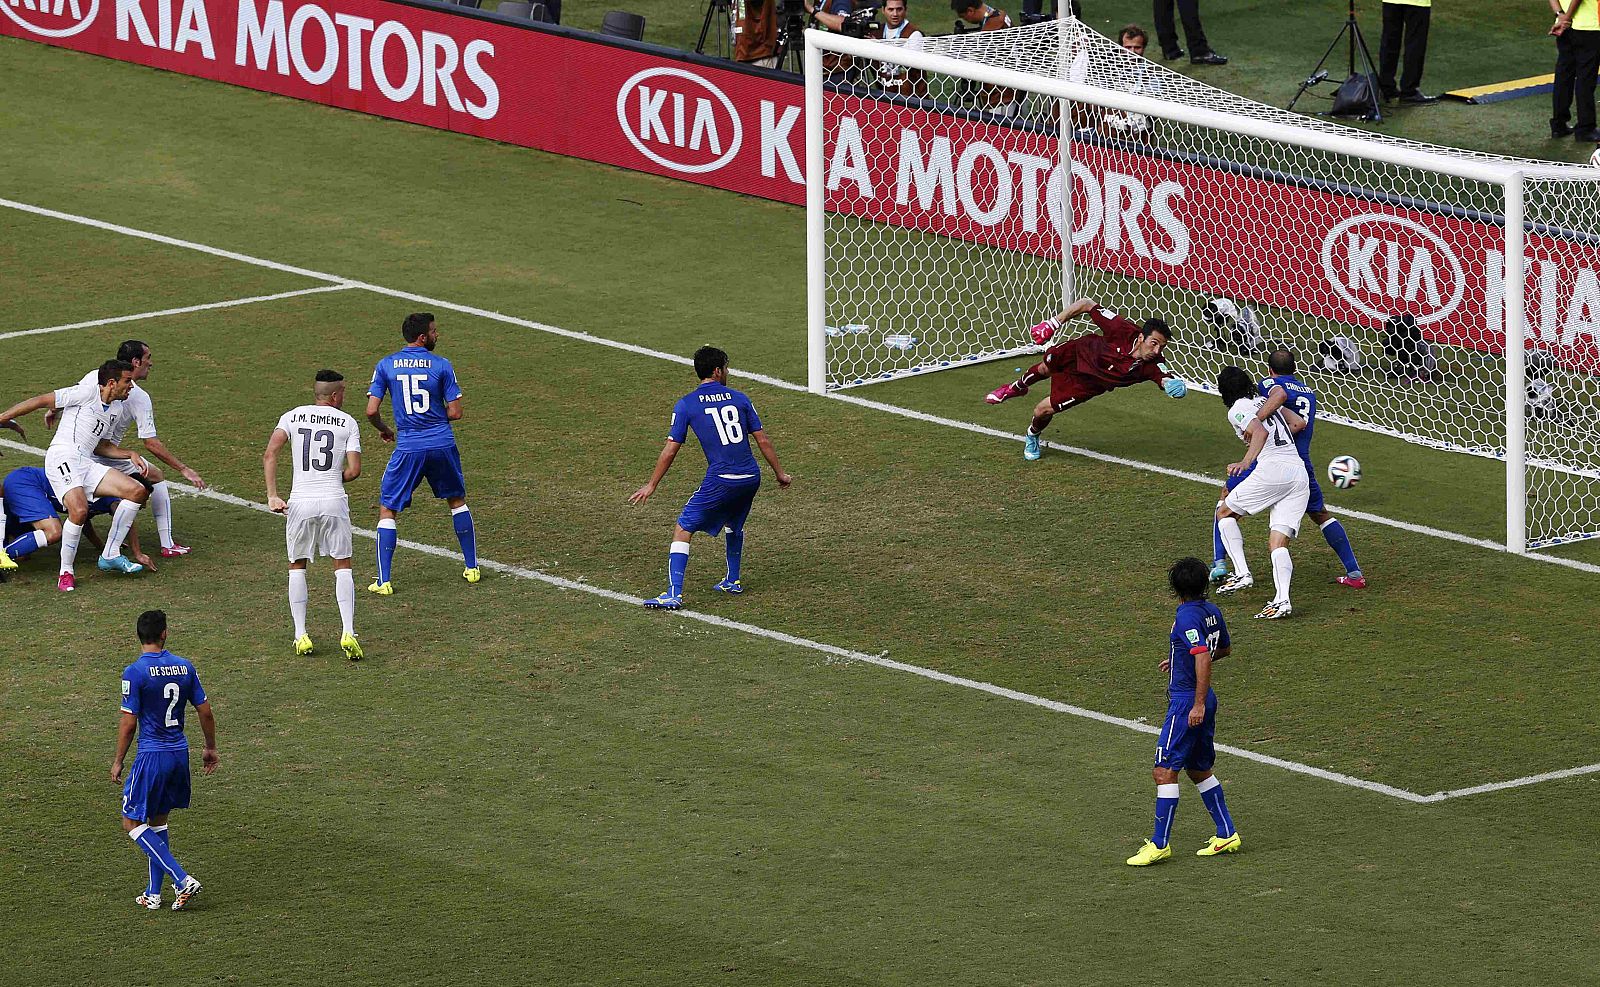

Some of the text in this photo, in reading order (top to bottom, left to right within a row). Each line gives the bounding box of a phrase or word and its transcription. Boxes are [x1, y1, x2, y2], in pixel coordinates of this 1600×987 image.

[115, 0, 498, 121] KIA MOTORS
[638, 85, 721, 156] KIA
[760, 99, 1190, 267] KA MOTORS
[1347, 230, 1443, 307] KIA
[393, 359, 432, 369] BARZAGLI
[397, 374, 430, 415] 15
[698, 392, 732, 403] PAROLO
[92, 418, 105, 437] 11
[291, 413, 346, 428] J.M. GIMÉNEZ
[704, 405, 744, 446] 18
[57, 461, 72, 476] 11
[297, 427, 335, 472] 13
[149, 665, 188, 677] DE SCIGLIO
[163, 682, 180, 728] 2
